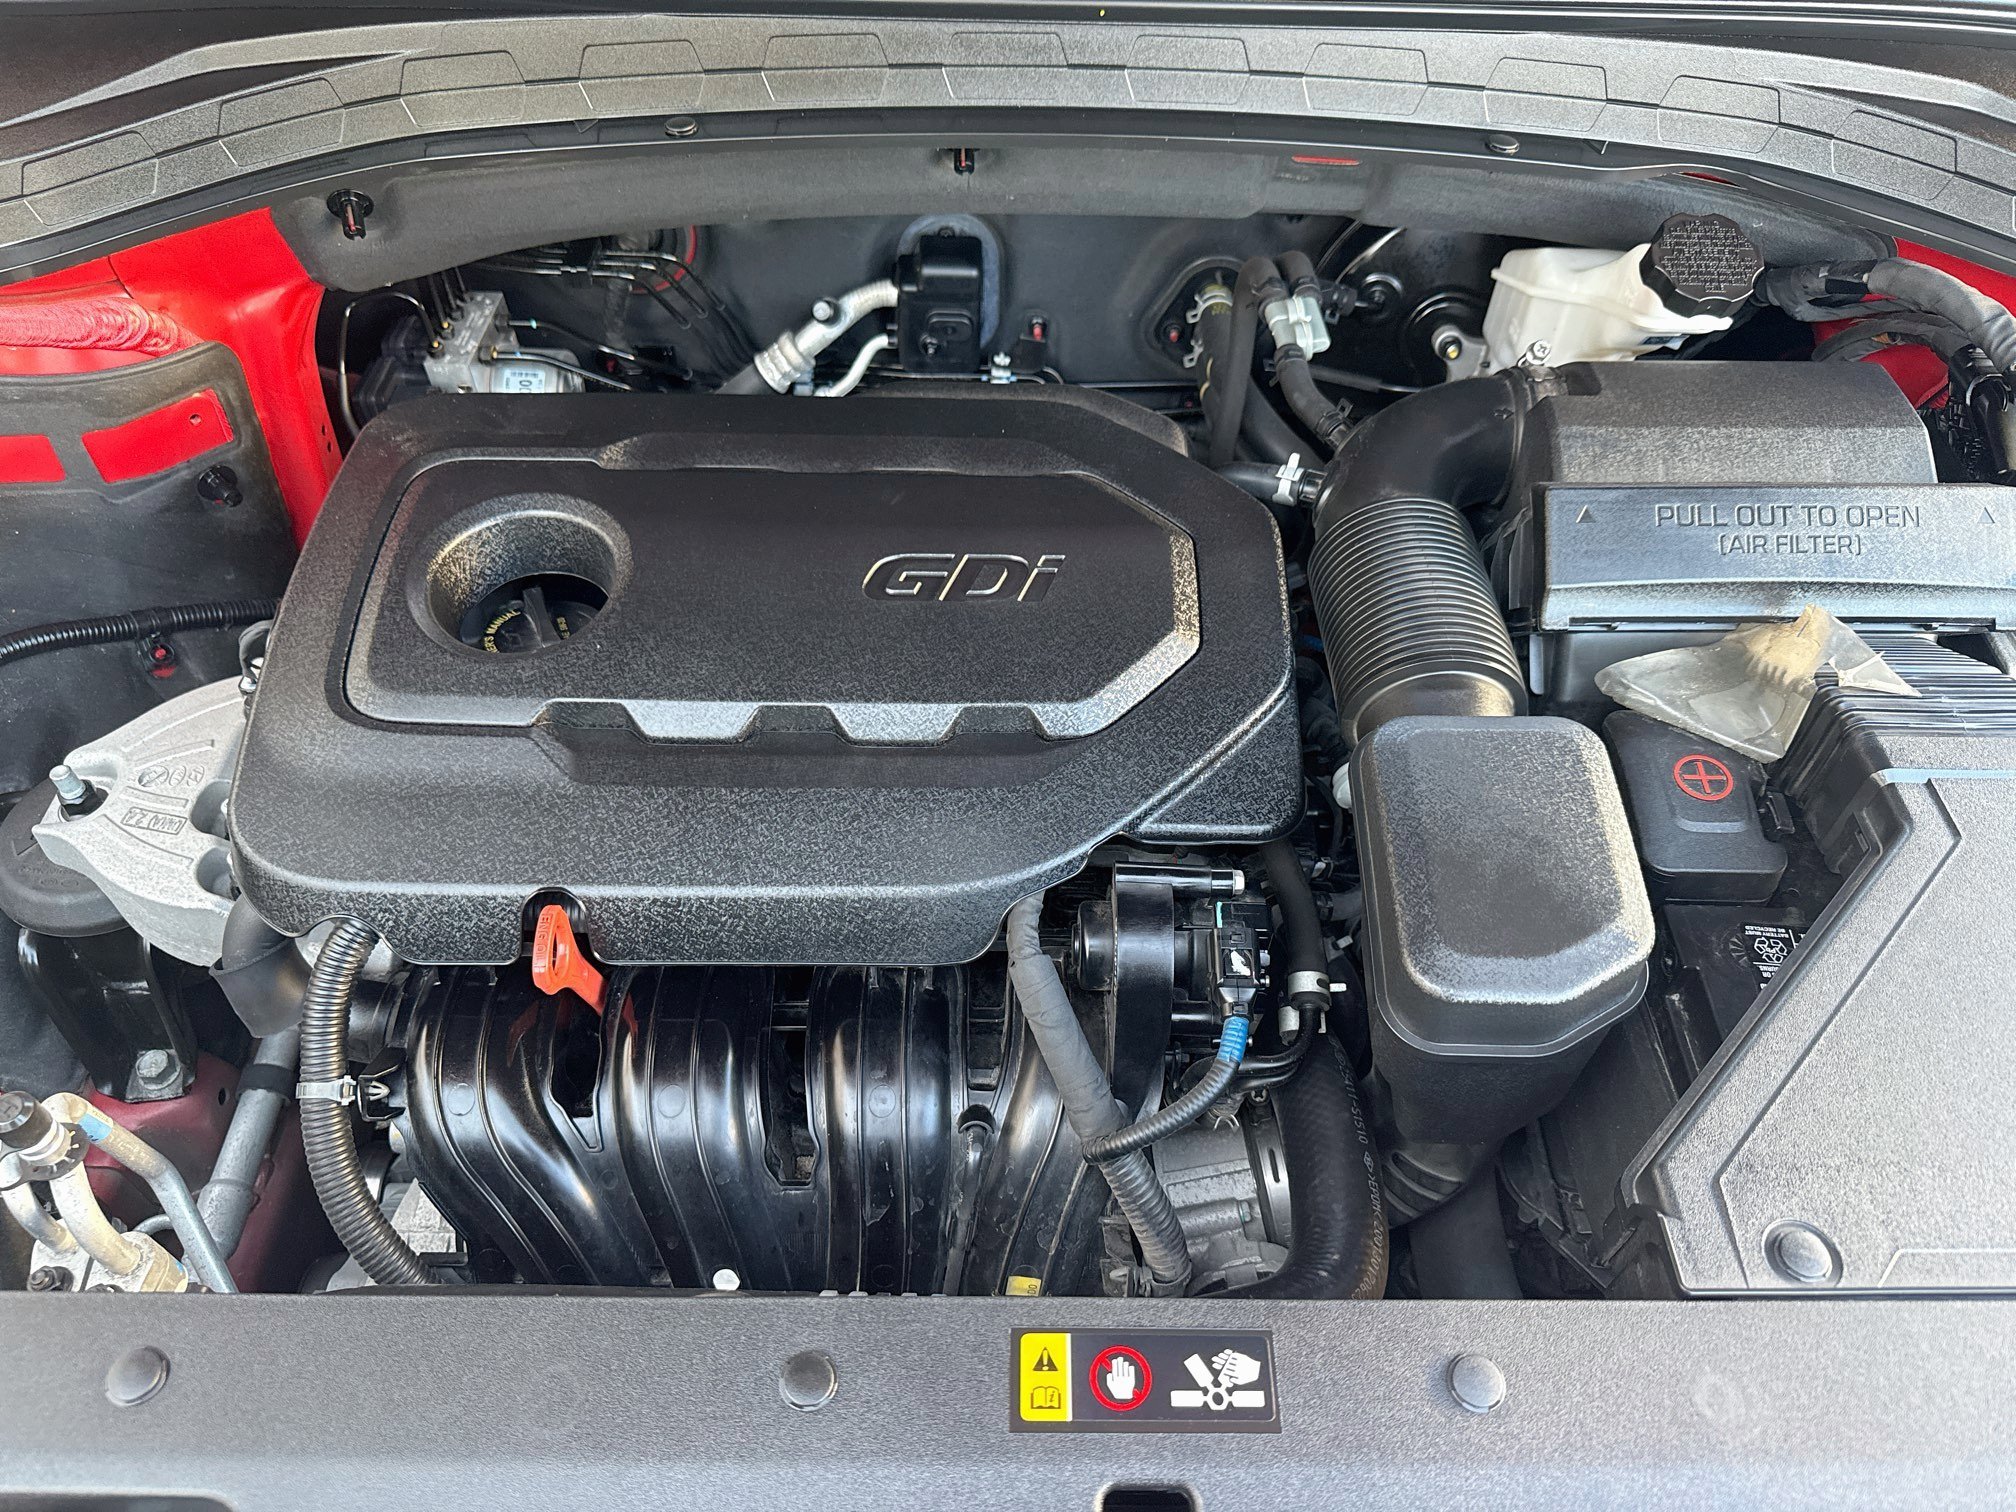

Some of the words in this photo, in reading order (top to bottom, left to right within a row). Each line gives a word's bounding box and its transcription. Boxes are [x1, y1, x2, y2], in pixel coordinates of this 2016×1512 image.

[1655, 504, 1728, 527] PULL
[1735, 504, 1792, 527] OUT
[1800, 504, 1837, 527] TO
[1846, 504, 1920, 528] OPEN
[539, 914, 551, 940] ENG
